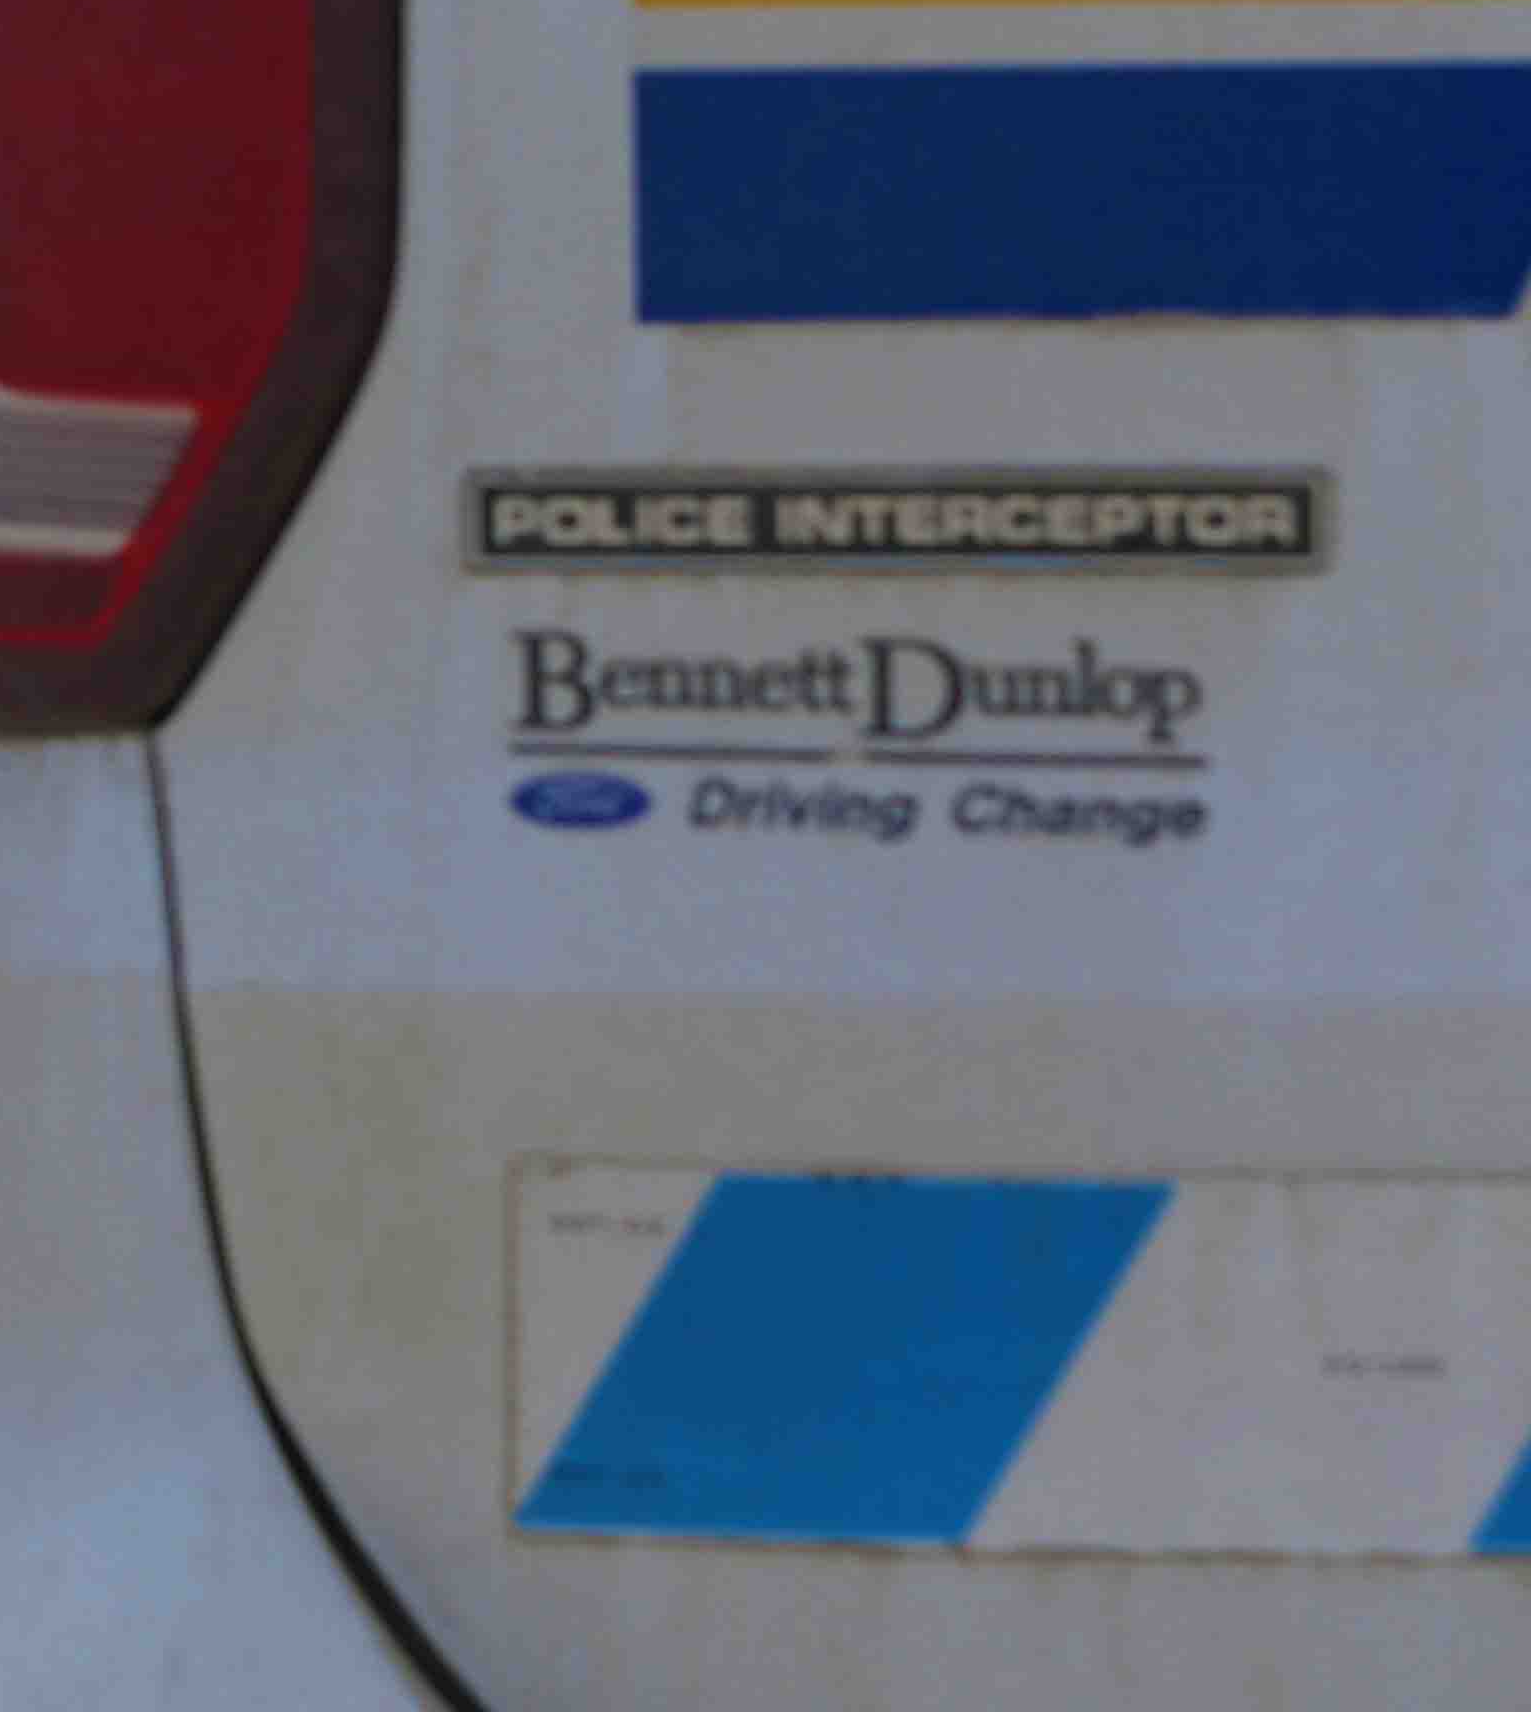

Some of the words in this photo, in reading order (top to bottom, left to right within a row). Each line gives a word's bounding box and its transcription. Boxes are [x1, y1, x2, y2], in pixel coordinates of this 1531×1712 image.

[491, 492, 750, 546] POLICE
[775, 494, 1297, 546] INTERCEPTOR
[511, 627, 856, 735] Bennett
[858, 635, 1204, 743] Dunlop
[686, 776, 921, 843] Driving
[949, 781, 1207, 848] Change
